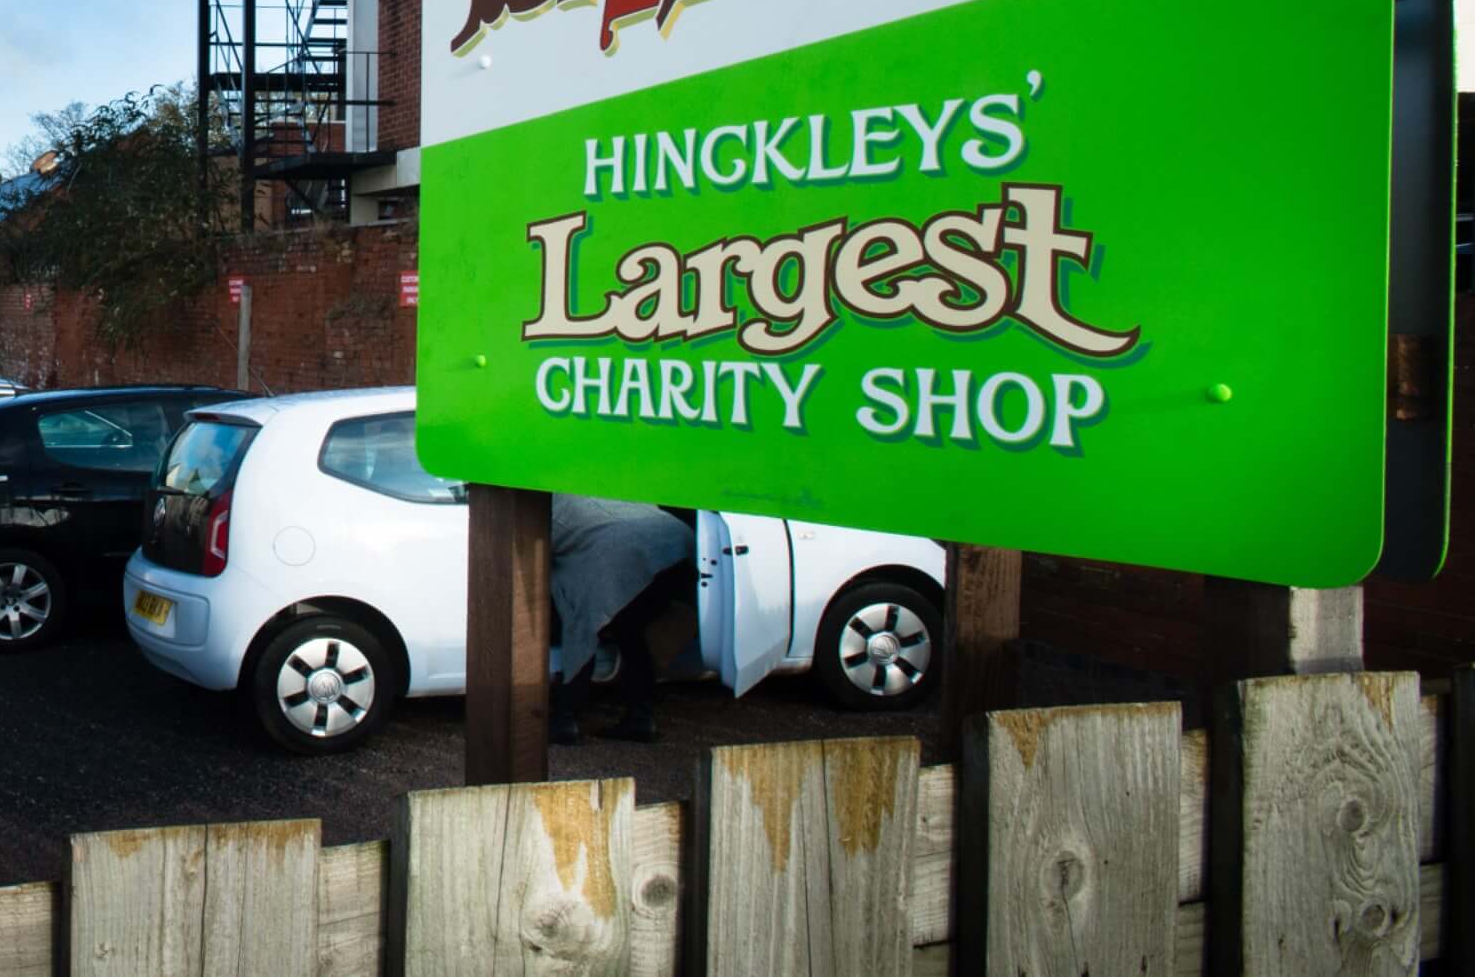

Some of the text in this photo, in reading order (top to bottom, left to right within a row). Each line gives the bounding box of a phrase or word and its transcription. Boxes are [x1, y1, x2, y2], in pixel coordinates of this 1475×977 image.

[583, 69, 1044, 196] HINCKLEYS'
[521, 182, 1141, 358] Largest
[535, 356, 1105, 447] CHARITY SHOP
